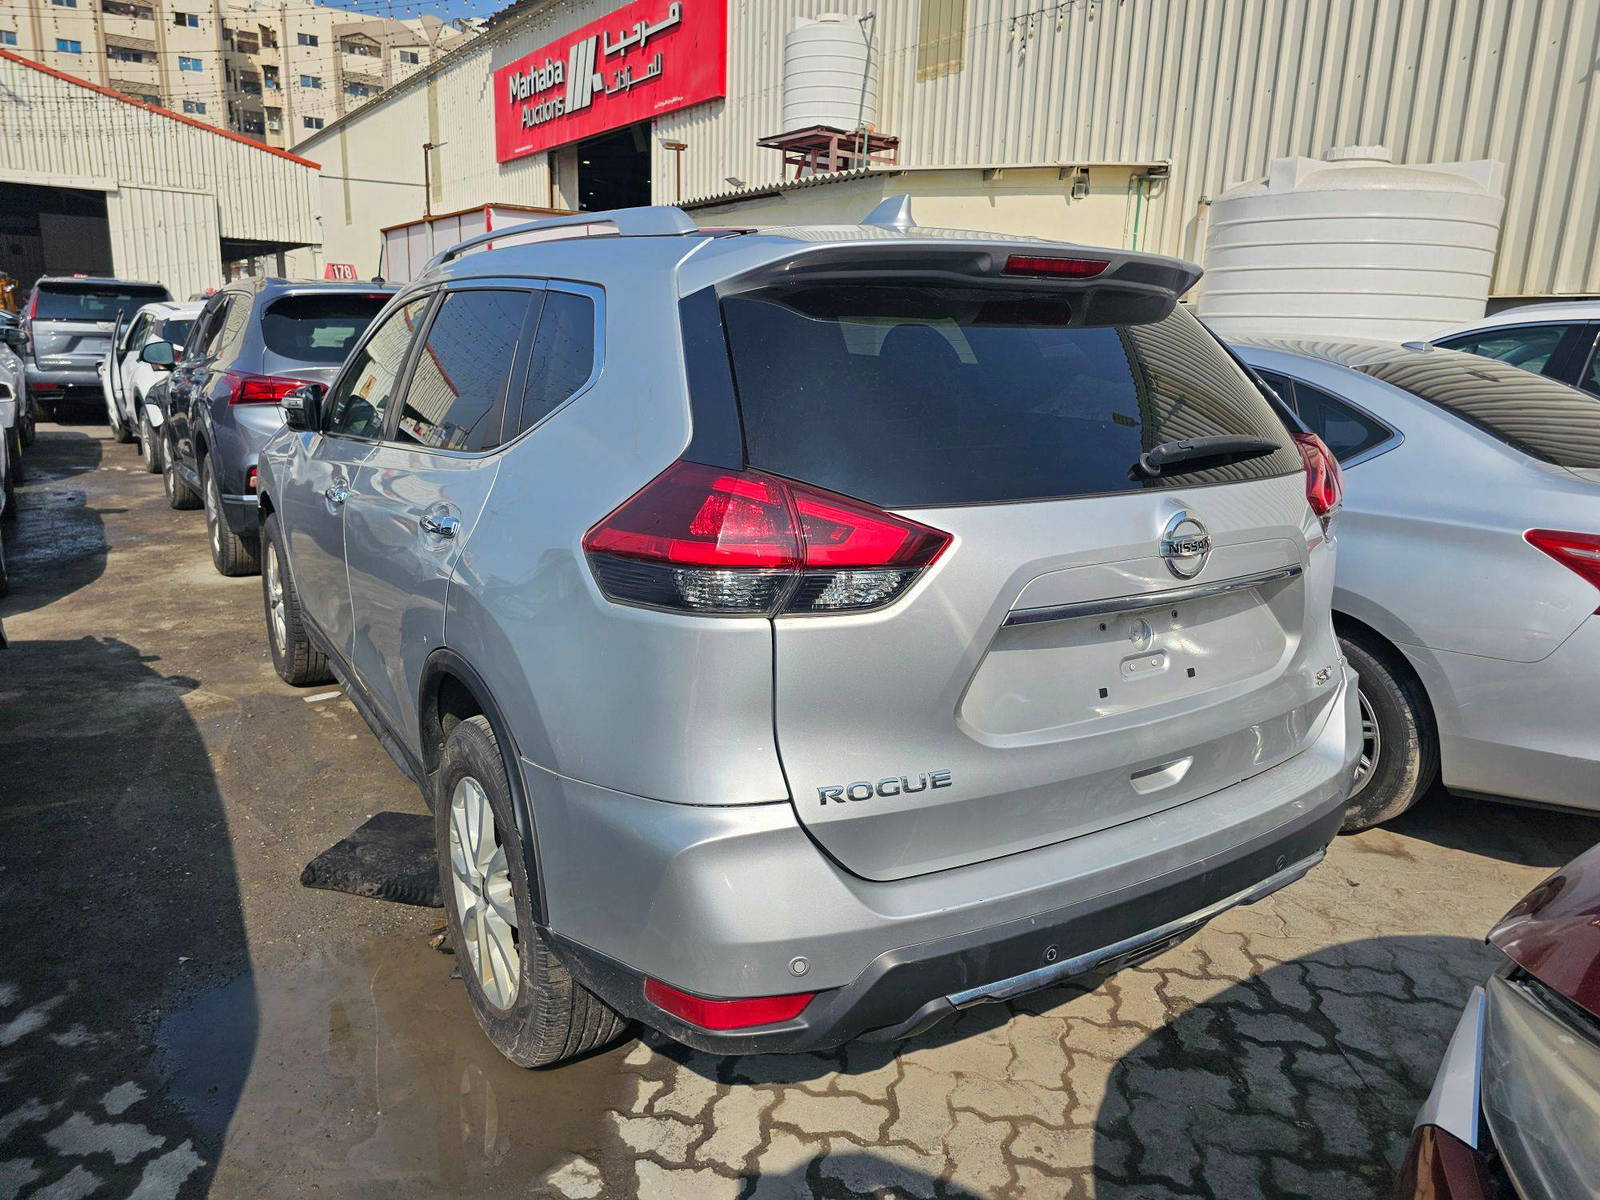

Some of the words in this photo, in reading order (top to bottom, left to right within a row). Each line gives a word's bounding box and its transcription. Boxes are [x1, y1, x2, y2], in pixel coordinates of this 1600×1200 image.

[603, 1, 682, 56] مرحبا
[509, 58, 564, 104] Marhaba
[521, 96, 566, 129] Auctions
[333, 264, 353, 280] 178
[1168, 536, 1211, 555] NISSAN
[816, 768, 953, 806] ROGUE
